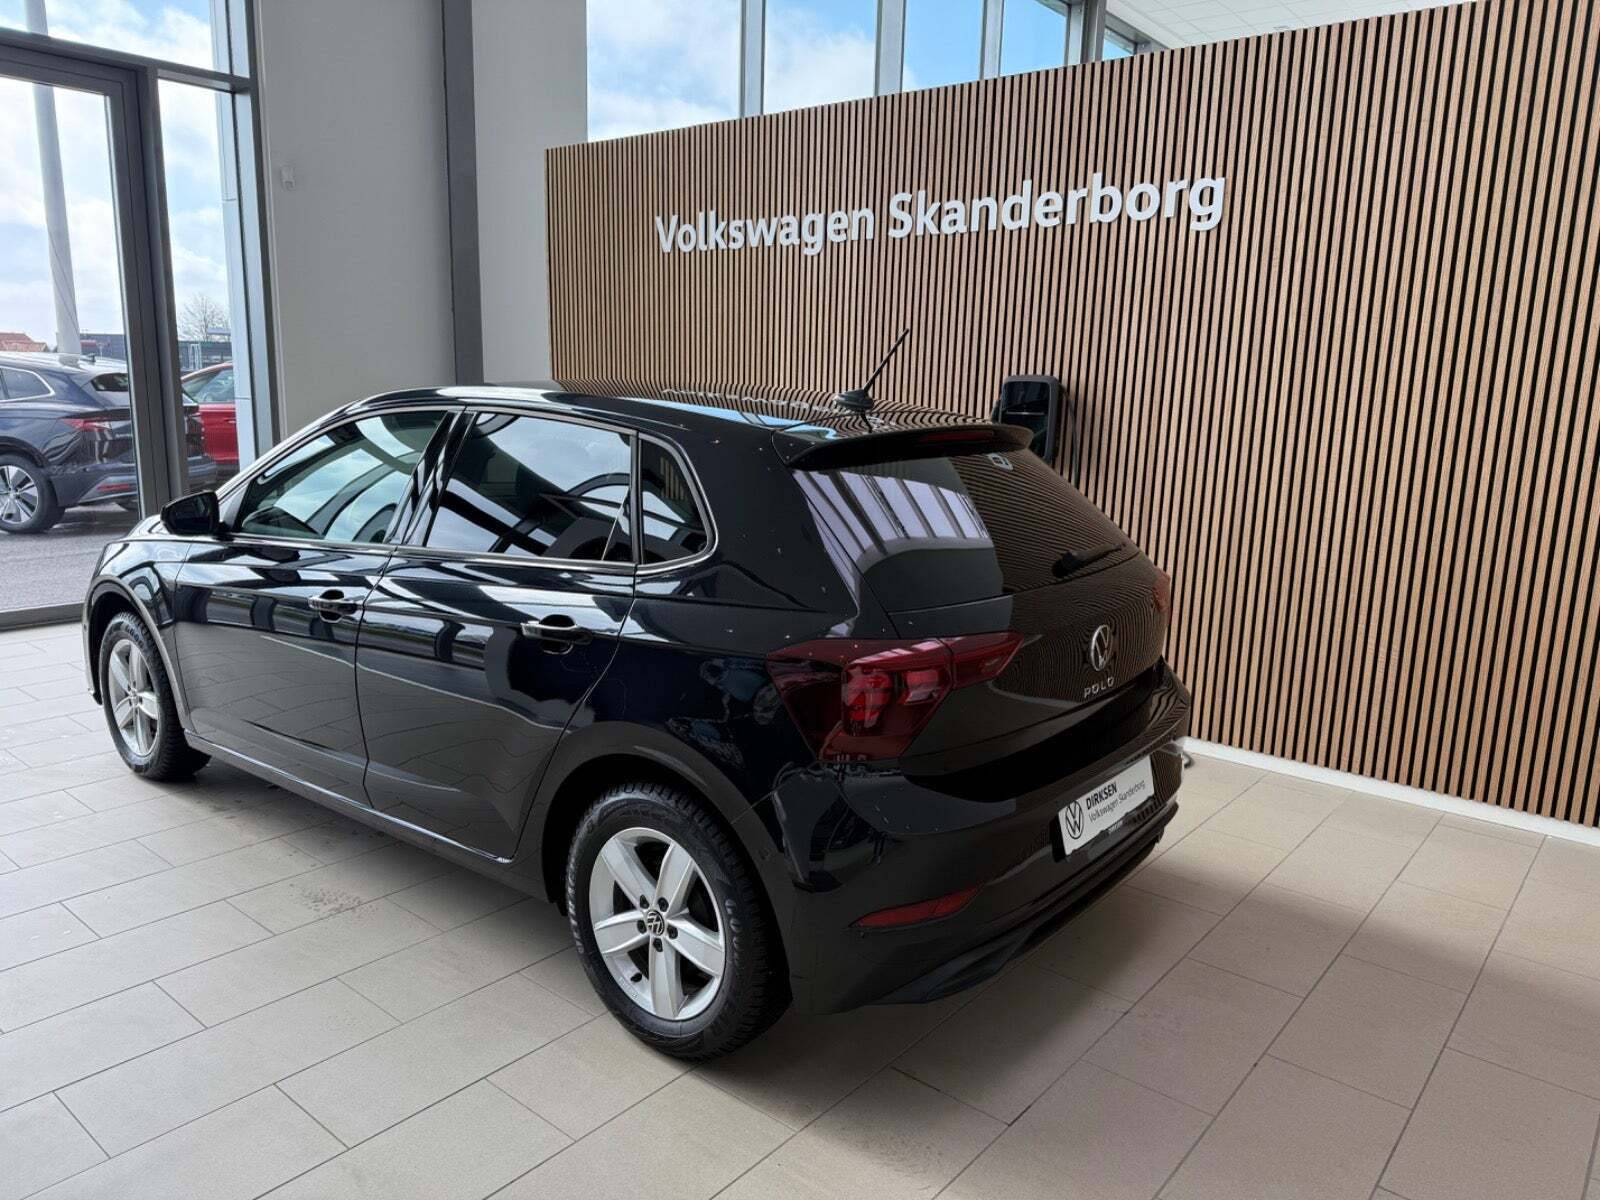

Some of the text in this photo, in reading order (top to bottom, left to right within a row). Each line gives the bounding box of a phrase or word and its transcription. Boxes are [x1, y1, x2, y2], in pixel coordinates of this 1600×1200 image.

[655, 173, 1226, 256] Volkswagen Skanderborg
[1084, 676, 1114, 698] POLO
[1086, 782, 1117, 811] DIRKSEN
